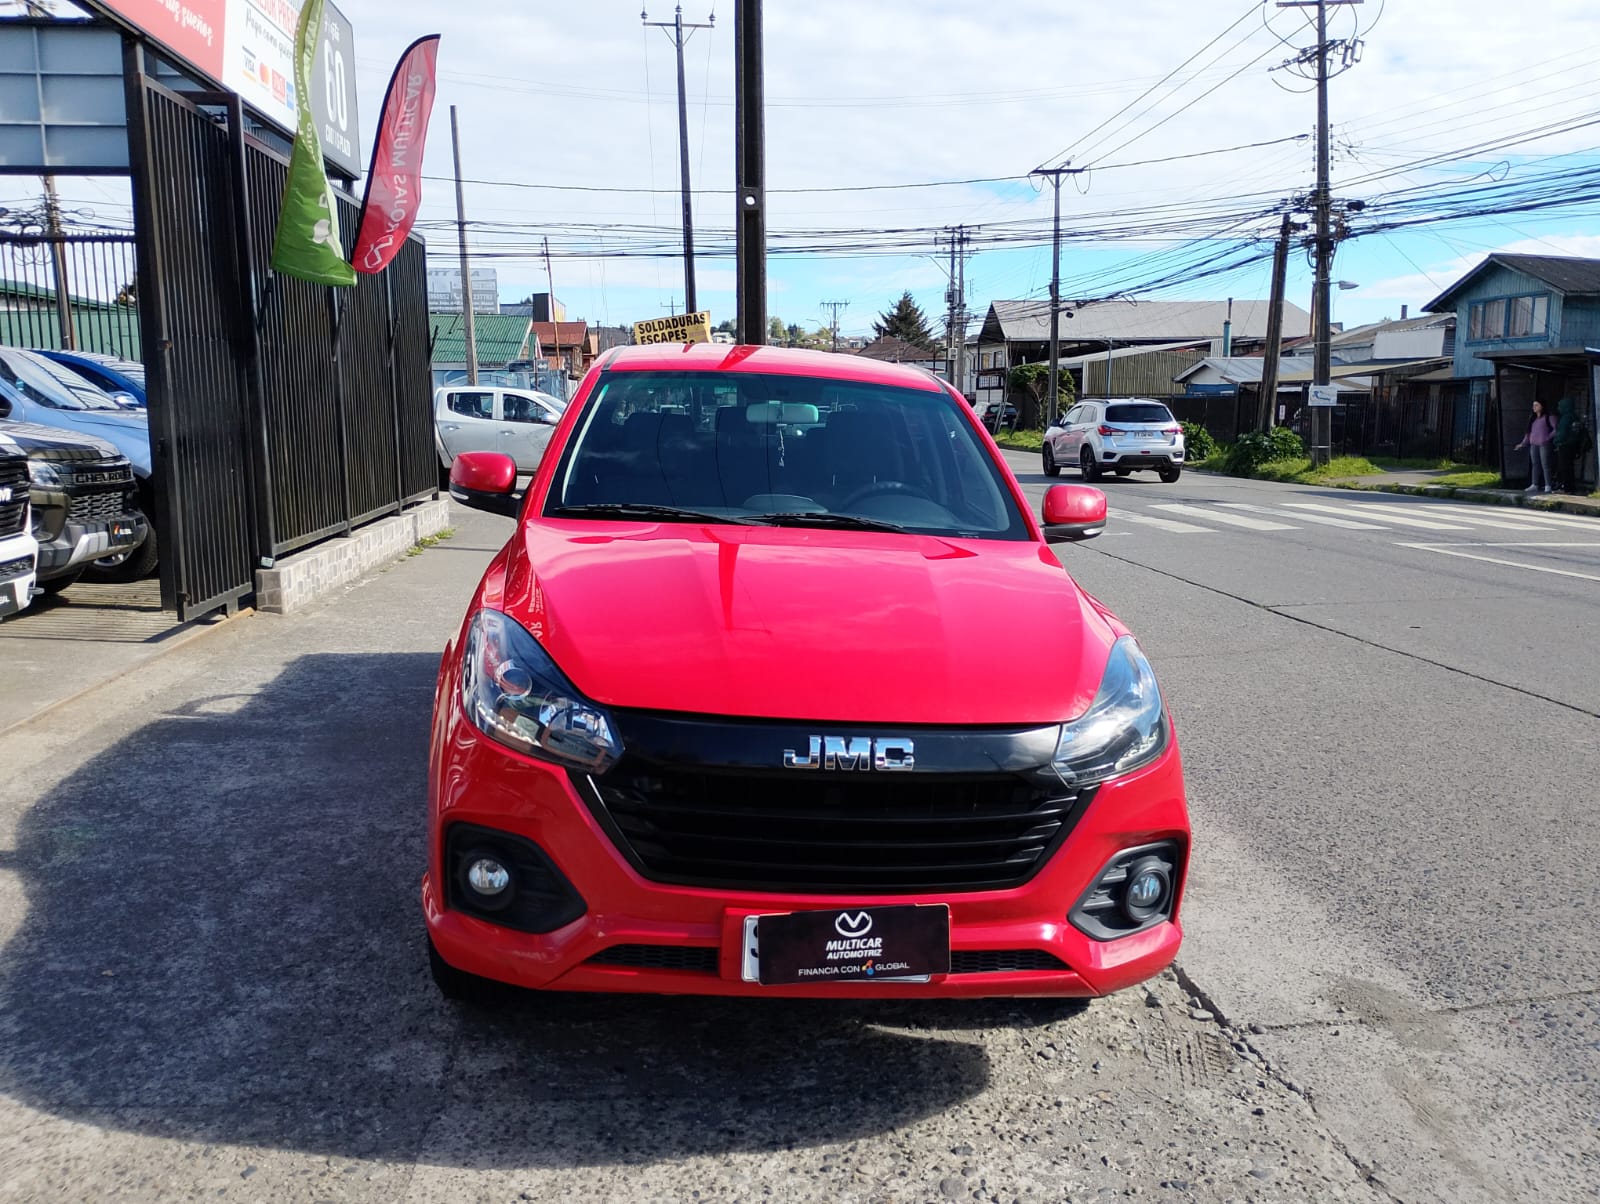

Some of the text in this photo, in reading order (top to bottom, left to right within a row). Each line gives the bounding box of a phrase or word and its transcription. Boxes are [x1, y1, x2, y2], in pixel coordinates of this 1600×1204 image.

[324, 39, 348, 132] 60
[638, 314, 705, 335] SOLDADURAS
[640, 328, 688, 345] ESCAPES
[783, 734, 915, 772] JMC
[825, 937, 883, 952] MULTICAR
[826, 949, 883, 960] AUTOMOTRIZ
[798, 962, 910, 976] FINANCIA CON GLOBAL
